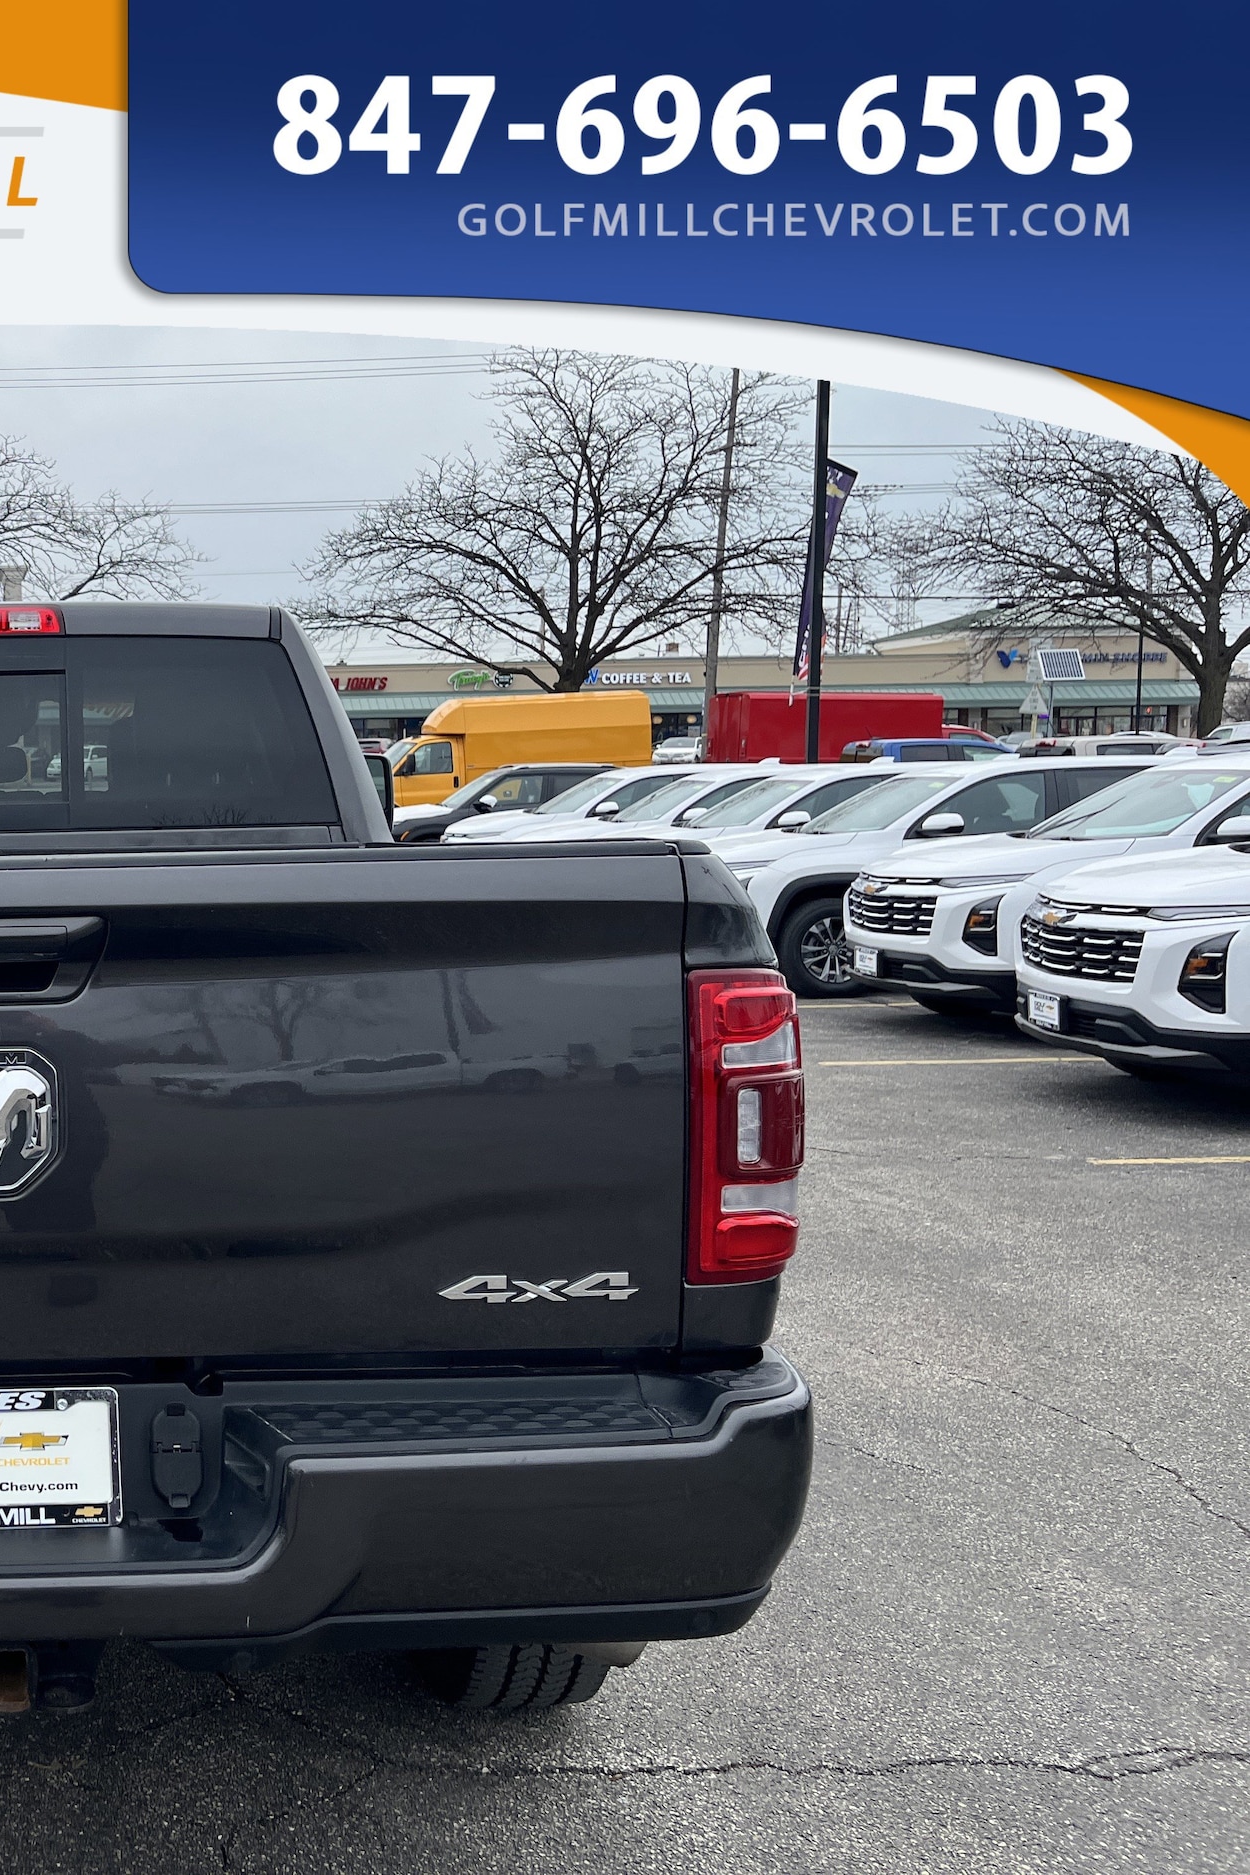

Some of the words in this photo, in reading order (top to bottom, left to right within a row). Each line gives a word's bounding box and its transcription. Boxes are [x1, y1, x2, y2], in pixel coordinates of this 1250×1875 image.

[345, 676, 388, 691] JOHN'S
[601, 672, 647, 685] COFFEE
[651, 672, 662, 684] &
[667, 672, 692, 684] TEA
